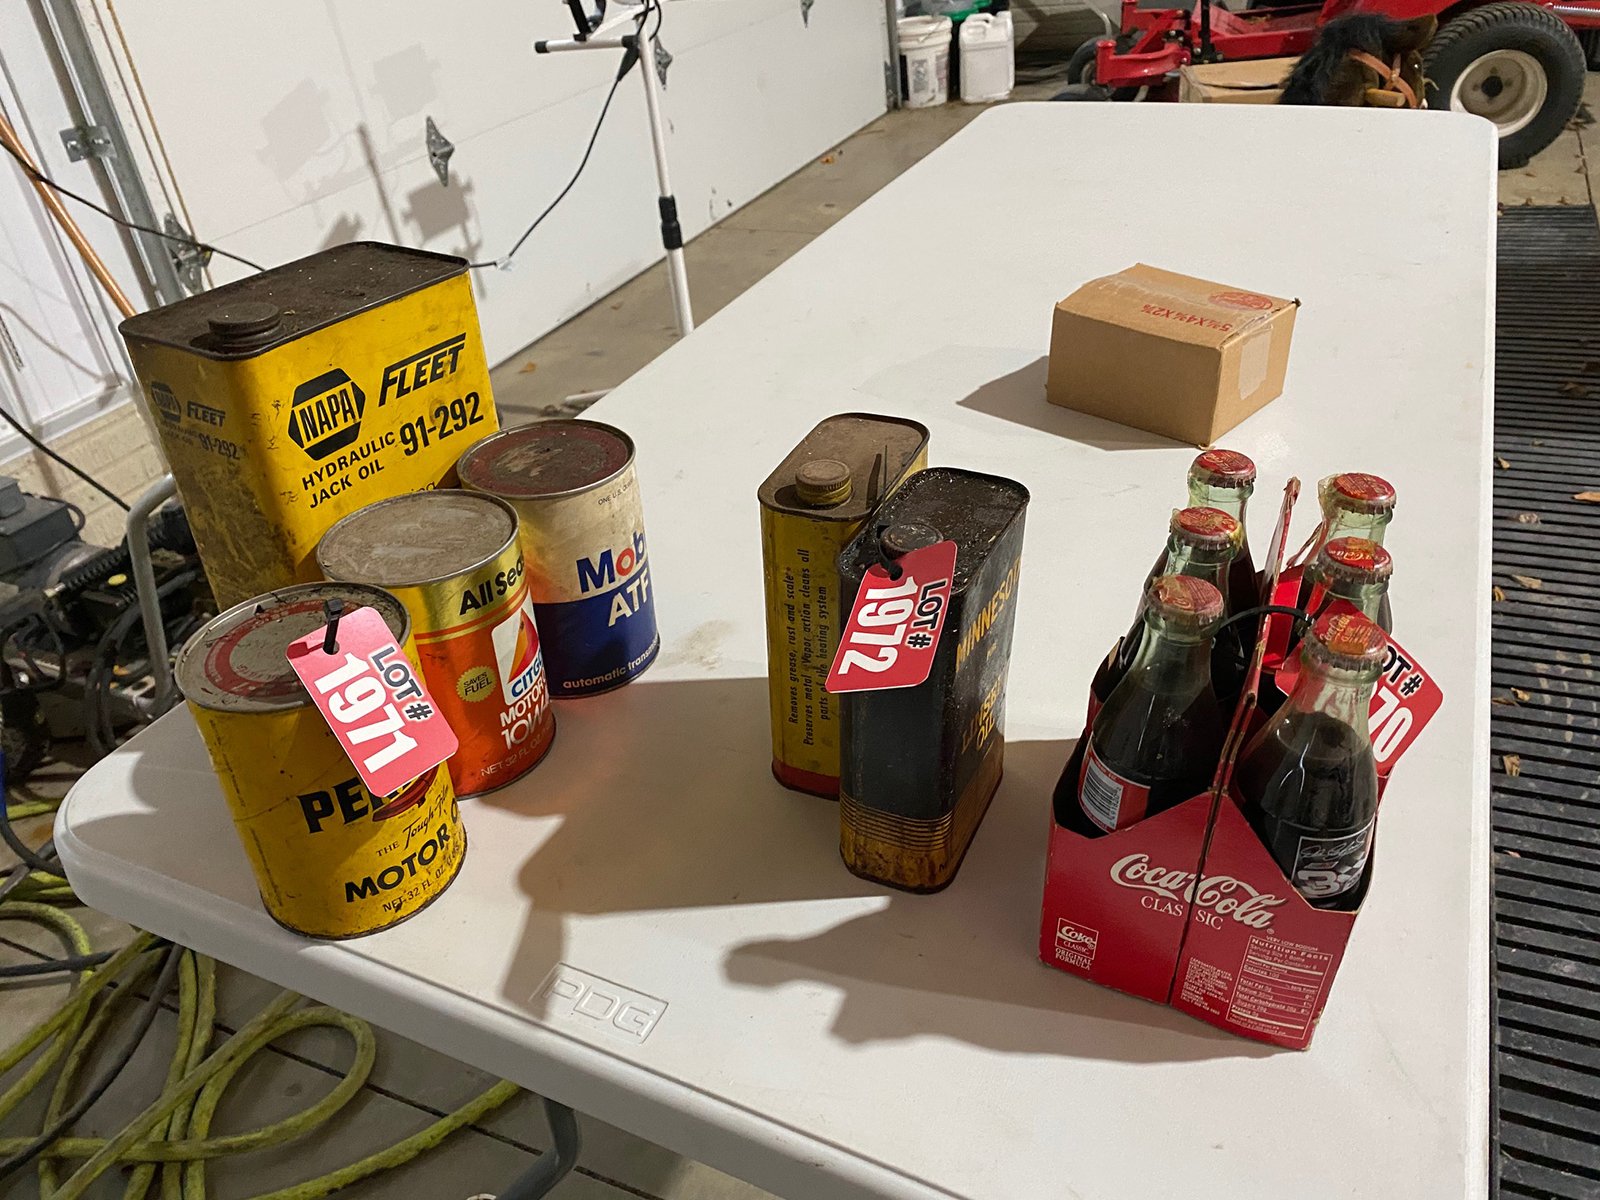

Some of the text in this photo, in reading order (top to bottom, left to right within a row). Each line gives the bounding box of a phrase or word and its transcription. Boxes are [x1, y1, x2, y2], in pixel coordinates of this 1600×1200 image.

[378, 332, 467, 407] FLEET
[187, 400, 226, 427] FLEET
[299, 388, 356, 442] NAPA
[400, 391, 484, 457] 91-292
[302, 431, 396, 491] HYDRAULIC
[309, 459, 385, 509] JACK OIL
[459, 580, 494, 616] All
[608, 567, 650, 627] ATF
[784, 604, 795, 622] and
[817, 586, 829, 619] system
[907, 580, 947, 648] LOT #
[786, 627, 797, 645] rust
[816, 624, 829, 659] heating
[838, 576, 919, 675] 1972
[797, 548, 814, 745] Preserves metal Vapor action cleans all
[372, 646, 433, 720] LOT #
[463, 672, 487, 687] SAVES
[563, 666, 626, 690] automatic
[788, 650, 799, 682] grease,
[1383, 645, 1423, 696] OT #
[464, 678, 493, 697] FUEL
[500, 676, 545, 727] MOTOR
[313, 652, 418, 774] 1971
[788, 687, 798, 724] Removes
[818, 697, 830, 720] parts
[1368, 685, 1413, 762] 70
[481, 761, 503, 777] NET
[345, 823, 450, 903] MOTOR
[376, 841, 400, 857] THE
[408, 888, 420, 901] 32
[422, 880, 433, 891] FL
[1110, 854, 1287, 928] Coca-Cola
[1298, 870, 1340, 895] 3
[1061, 926, 1095, 944] Coke
[1064, 941, 1090, 954] CLASSIC
[1251, 938, 1329, 961] Nutrition Facts
[1056, 948, 1091, 966] ORIGINAL
[1056, 953, 1090, 970] FORMULA
[543, 972, 657, 1037] PDG
